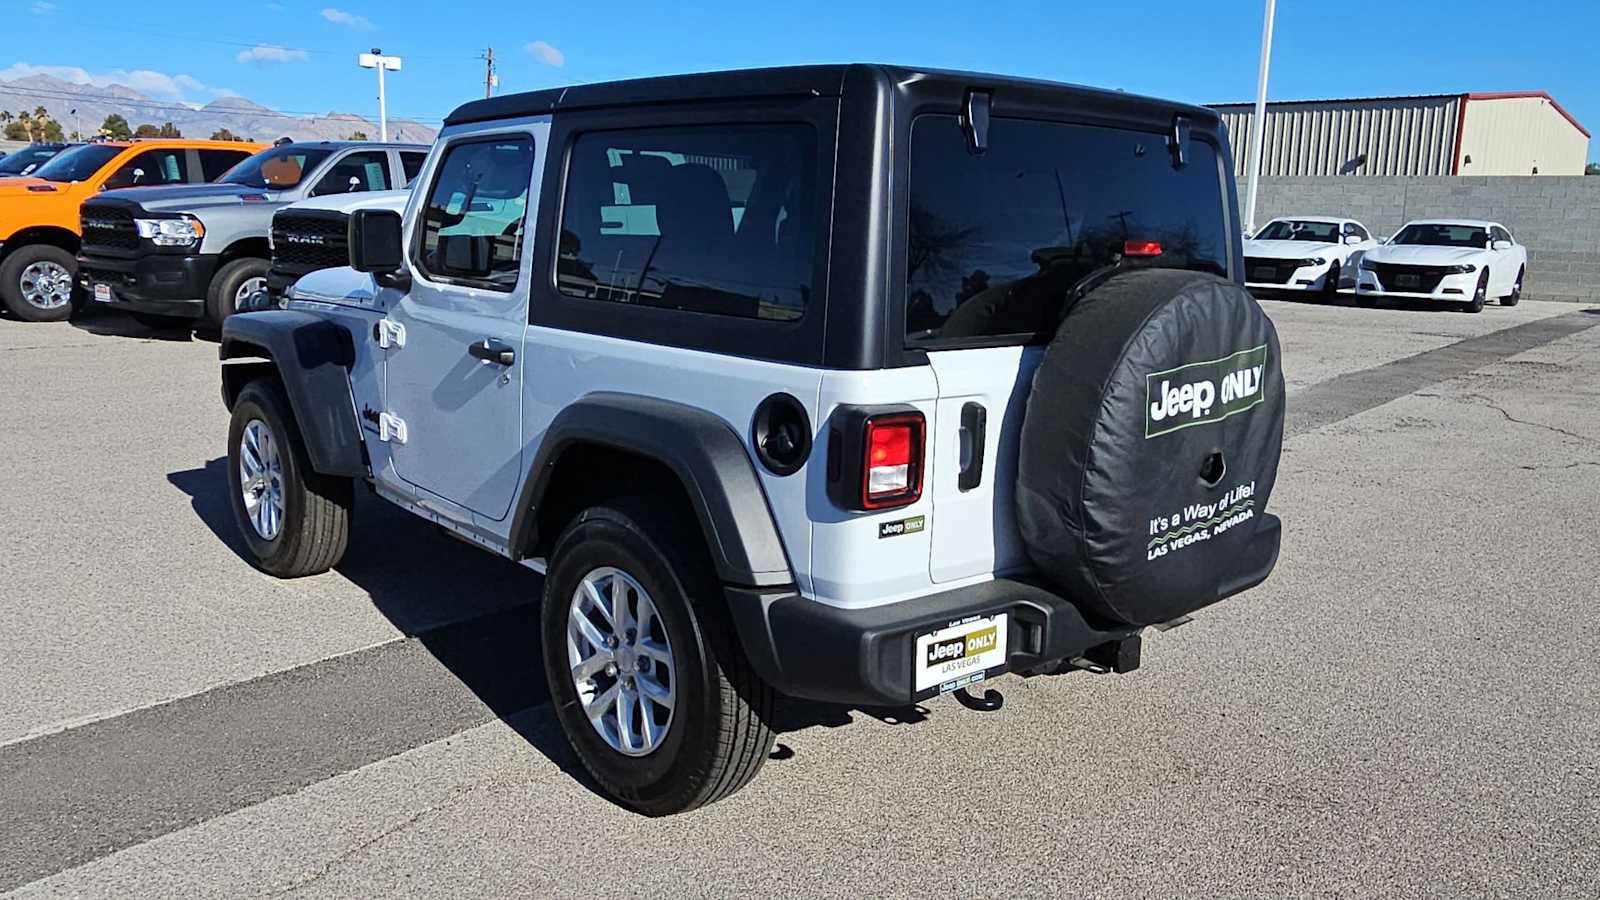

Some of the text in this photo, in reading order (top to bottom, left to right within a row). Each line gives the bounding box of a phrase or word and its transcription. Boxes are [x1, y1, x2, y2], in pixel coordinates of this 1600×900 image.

[1151, 364, 1262, 421] Jeep ONLY
[1149, 481, 1255, 535] It's a Way of Life!
[882, 523, 904, 535] Jeep
[1147, 509, 1254, 561] LAS VEGAS, NEVADA
[928, 632, 996, 661] Jeep ONLY
[942, 655, 981, 674] LAS VEGAS
